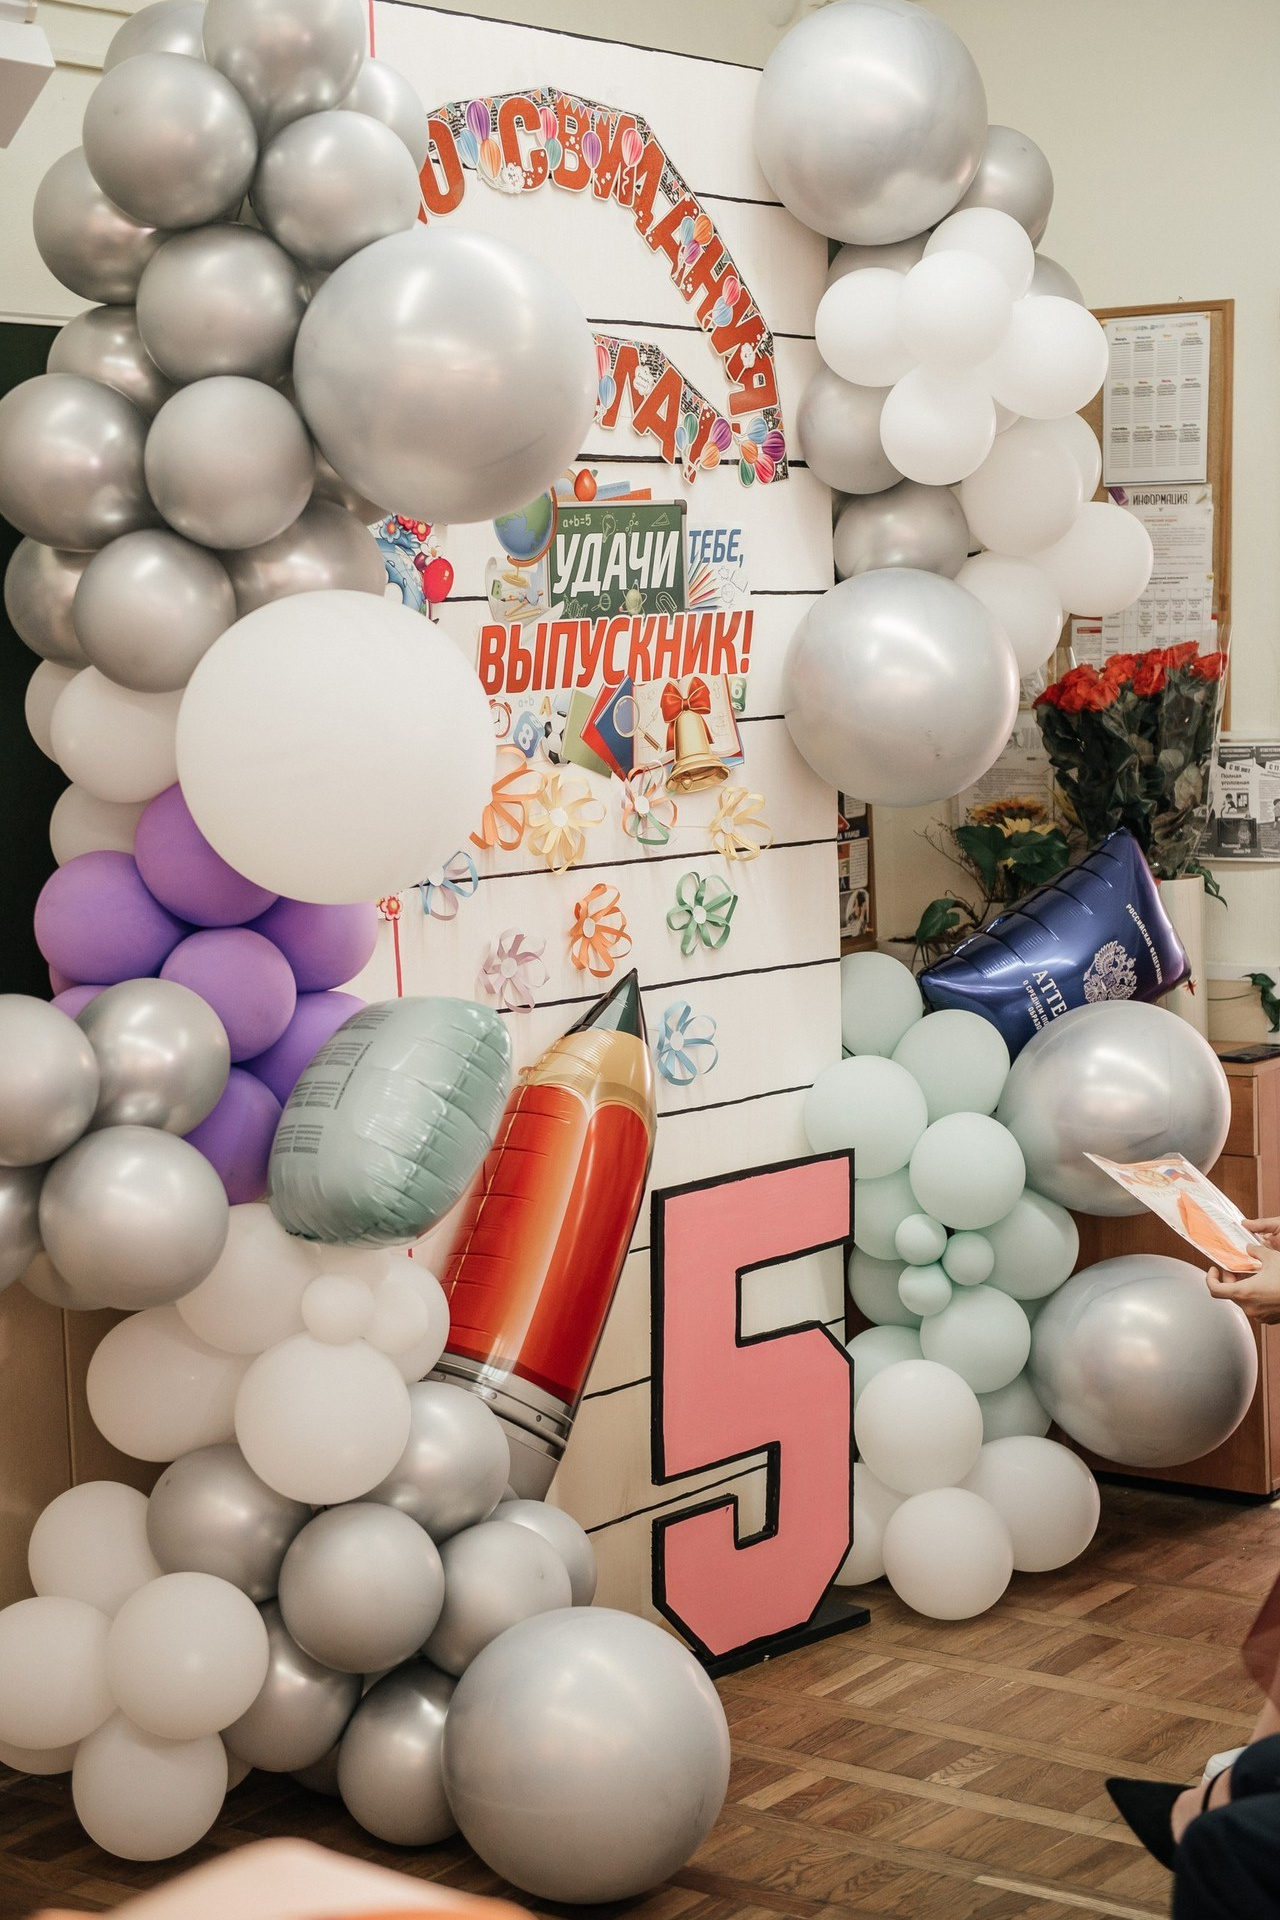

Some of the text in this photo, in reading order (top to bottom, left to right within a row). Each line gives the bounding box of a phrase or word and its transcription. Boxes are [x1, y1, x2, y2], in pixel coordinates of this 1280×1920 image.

[417, 118, 466, 226] О
[562, 513, 592, 529] a+b=5
[1132, 493, 1188, 506] ИНФОРМАЦИЯ
[552, 528, 745, 598] УДАЧИ ТЕБЕ,
[479, 609, 755, 696] ВЫПУСКНИК!
[1125, 903, 1153, 947] РОССИЙСКАЯ
[1025, 984, 1045, 1015] СРЕДНЕМ
[1031, 969, 1068, 1017] АТТЕ
[1027, 1006, 1043, 1031] ОБРАЗО
[651, 1148, 855, 1662] 5
